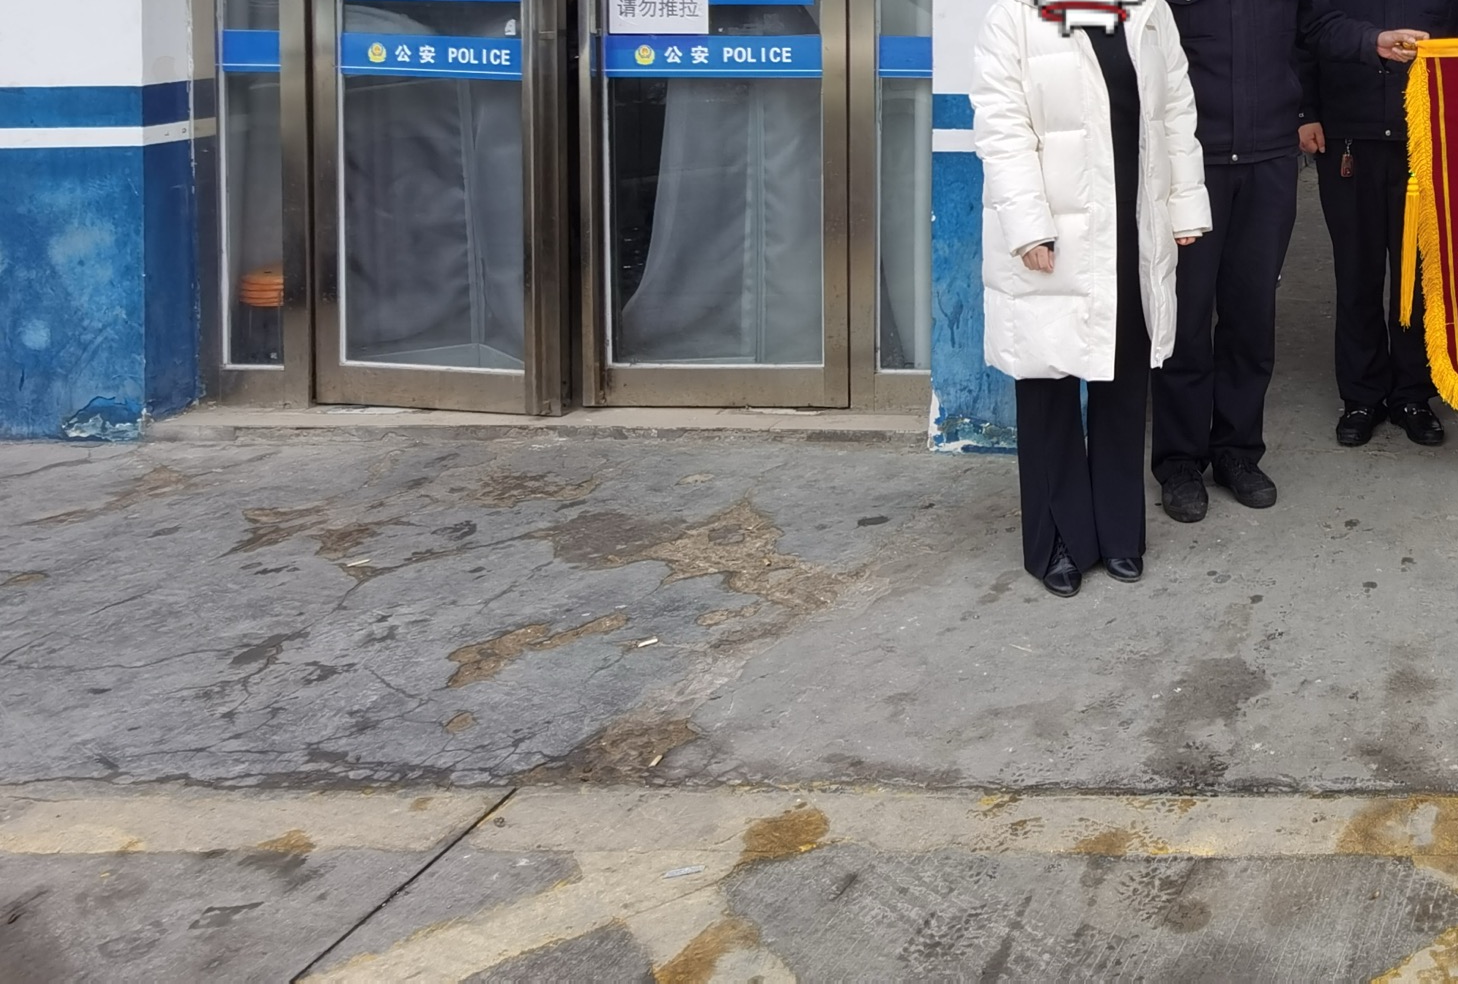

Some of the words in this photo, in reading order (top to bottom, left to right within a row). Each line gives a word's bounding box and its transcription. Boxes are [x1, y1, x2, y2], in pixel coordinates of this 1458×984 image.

[394, 44, 436, 64] 公安
[448, 47, 511, 66] POLICE
[664, 45, 709, 64] 公安
[722, 47, 792, 63] POLICE
